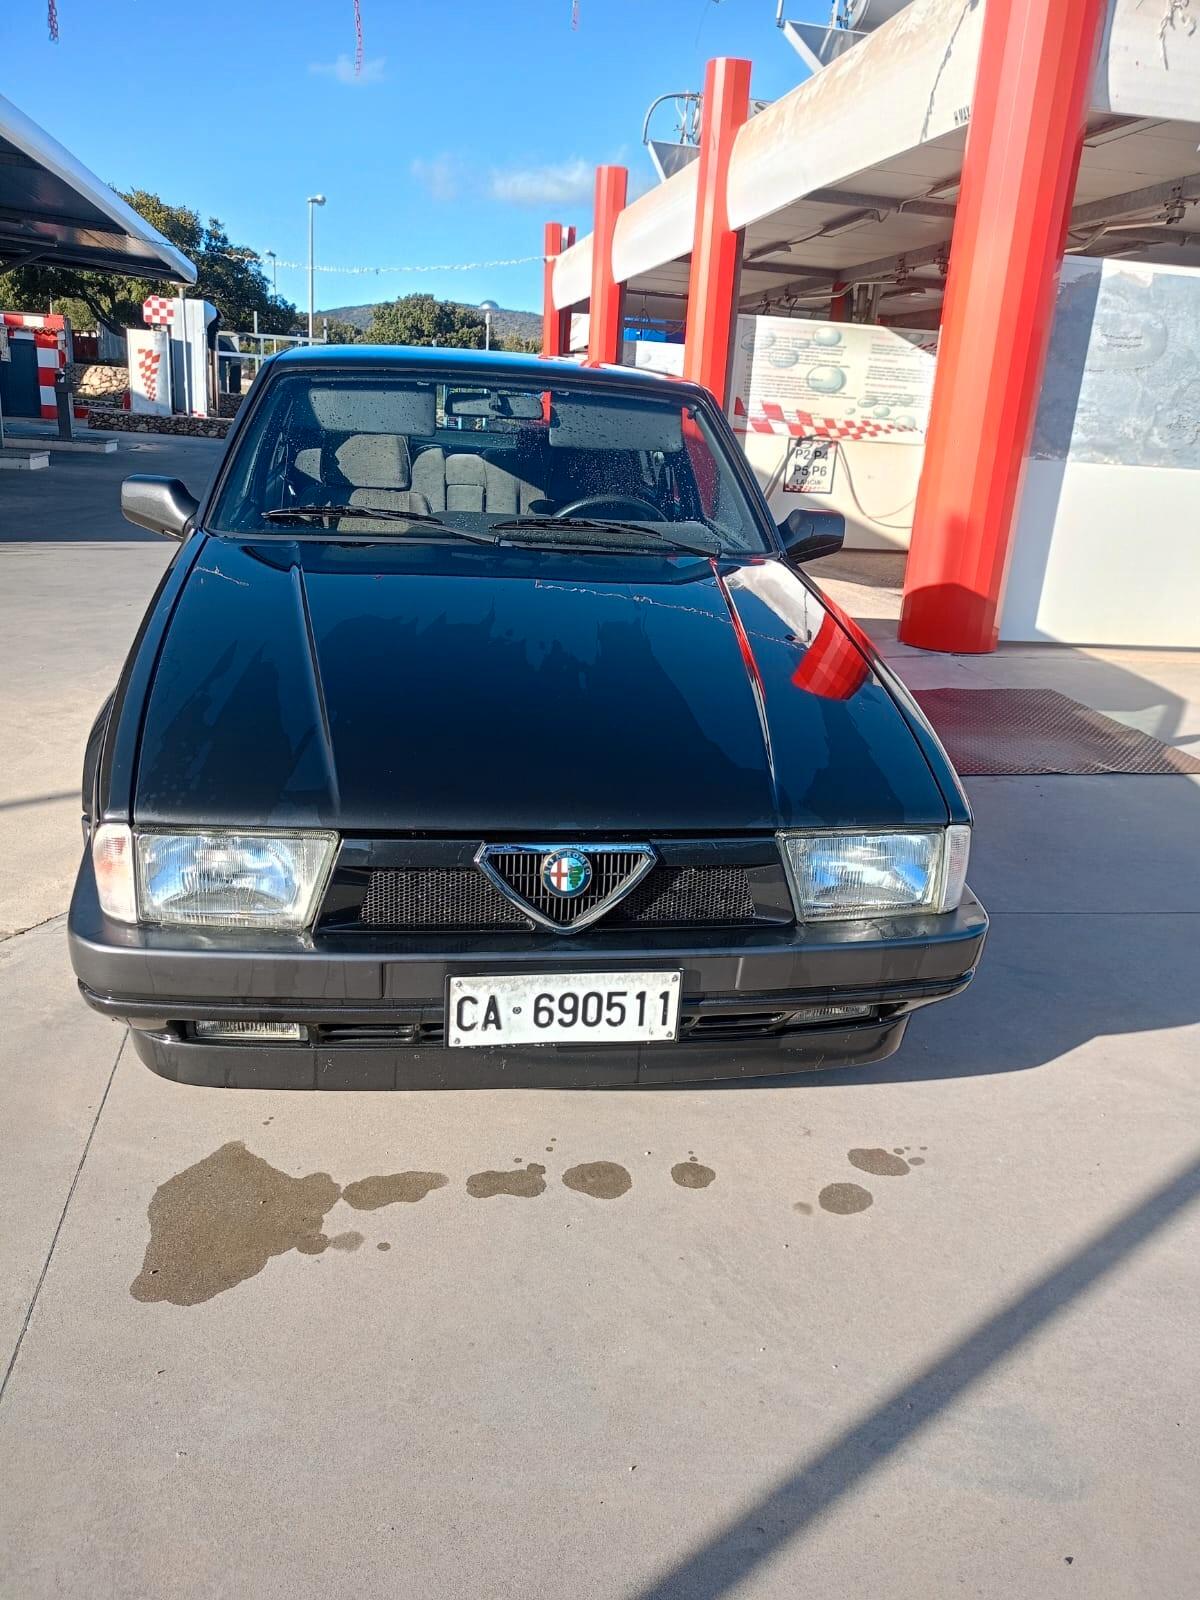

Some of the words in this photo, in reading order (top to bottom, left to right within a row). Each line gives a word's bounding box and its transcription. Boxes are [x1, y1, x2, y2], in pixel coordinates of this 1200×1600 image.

[812, 465, 828, 477] P6
[456, 994, 502, 1031] CA
[534, 991, 669, 1028] 690511
